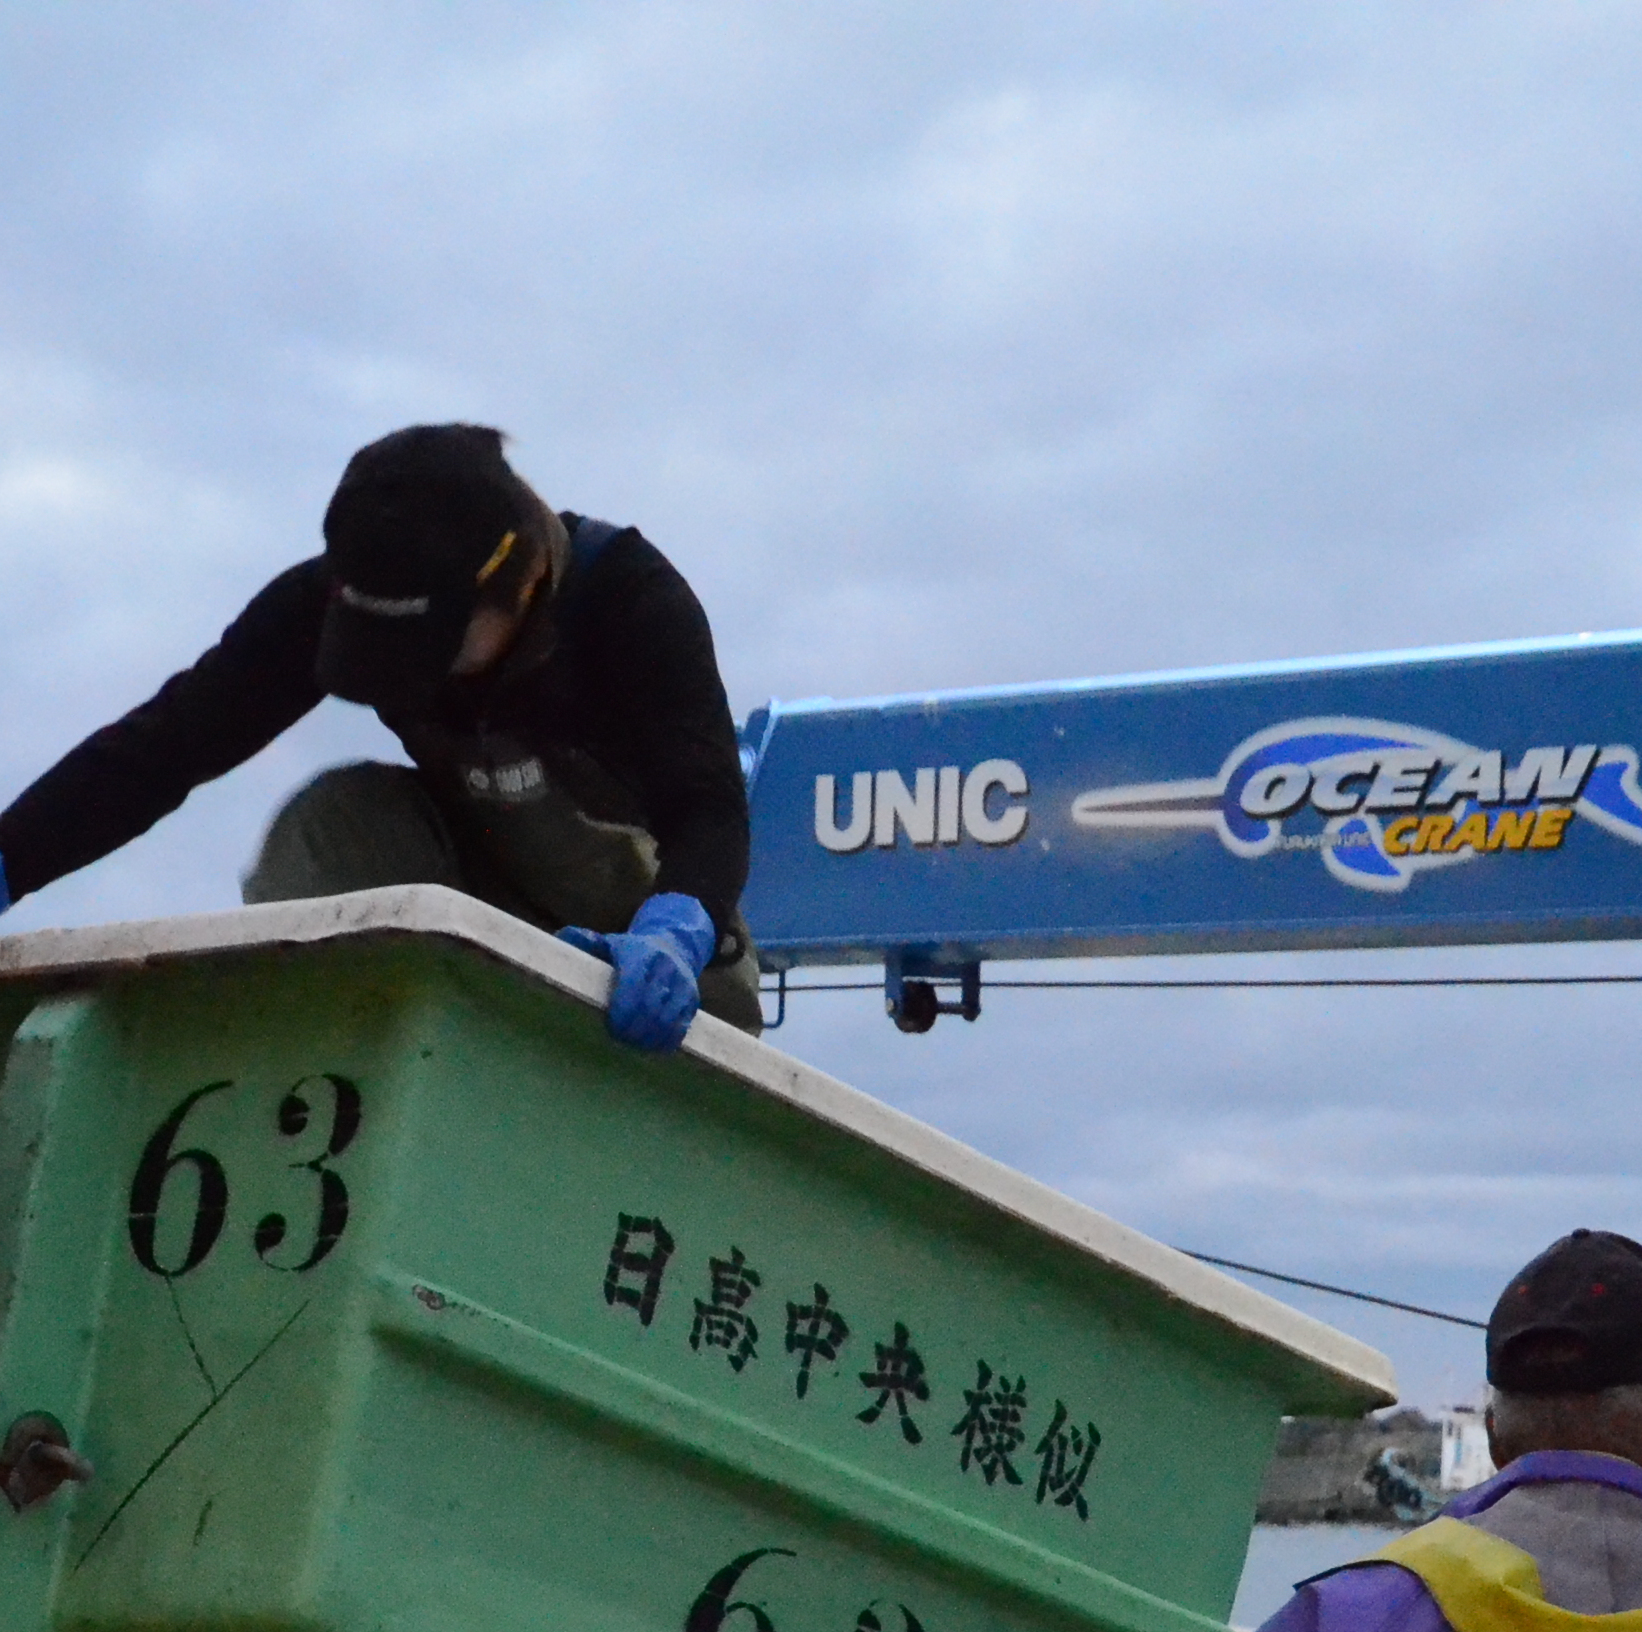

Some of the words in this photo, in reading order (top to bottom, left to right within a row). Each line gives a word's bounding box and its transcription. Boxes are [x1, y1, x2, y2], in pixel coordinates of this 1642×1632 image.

[814, 757, 1030, 852] UNIC
[1240, 744, 1599, 819] OCEAN
[1383, 808, 1574, 858] CRANE
[128, 1073, 361, 1277] 63
[603, 1212, 1101, 1522] 日高中央様似
